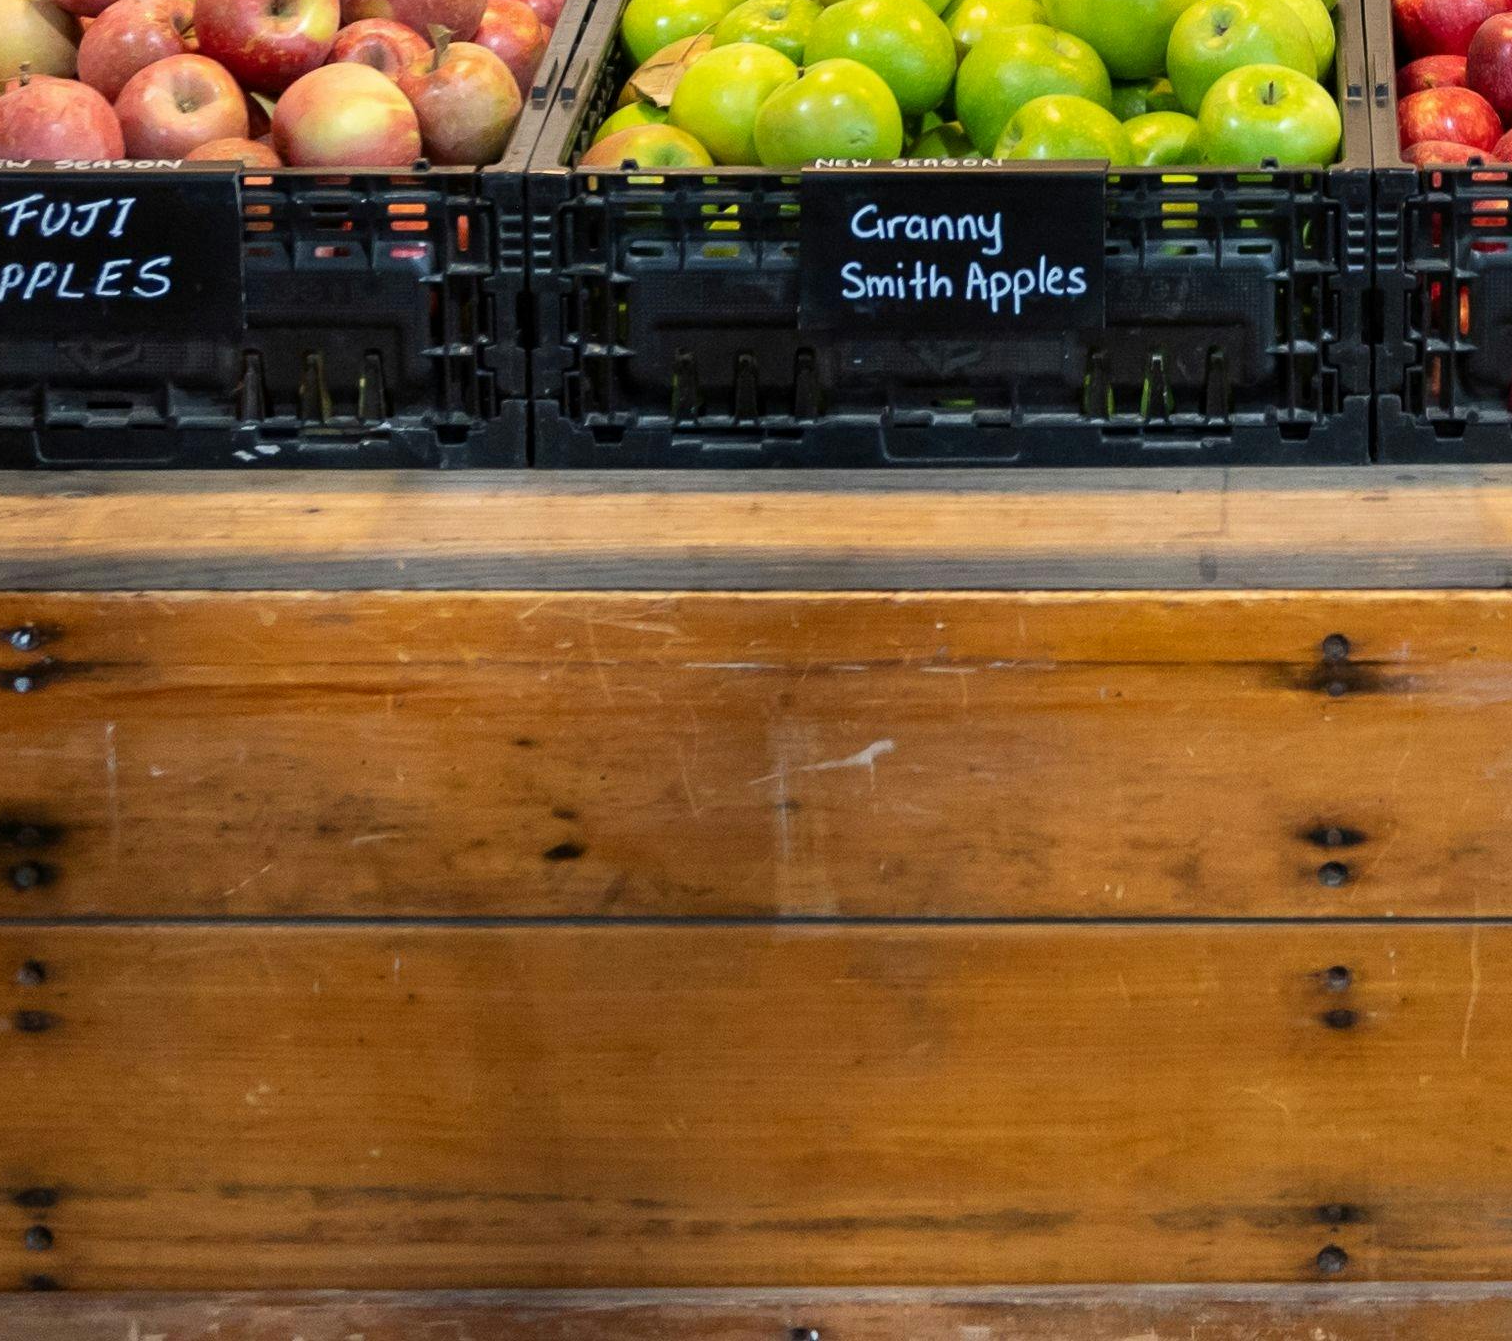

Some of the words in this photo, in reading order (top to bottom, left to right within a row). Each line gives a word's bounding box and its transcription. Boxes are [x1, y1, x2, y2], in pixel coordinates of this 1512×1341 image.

[850, 204, 1003, 255] Granny
[840, 260, 954, 301] Smith
[966, 255, 1088, 315] Apples
